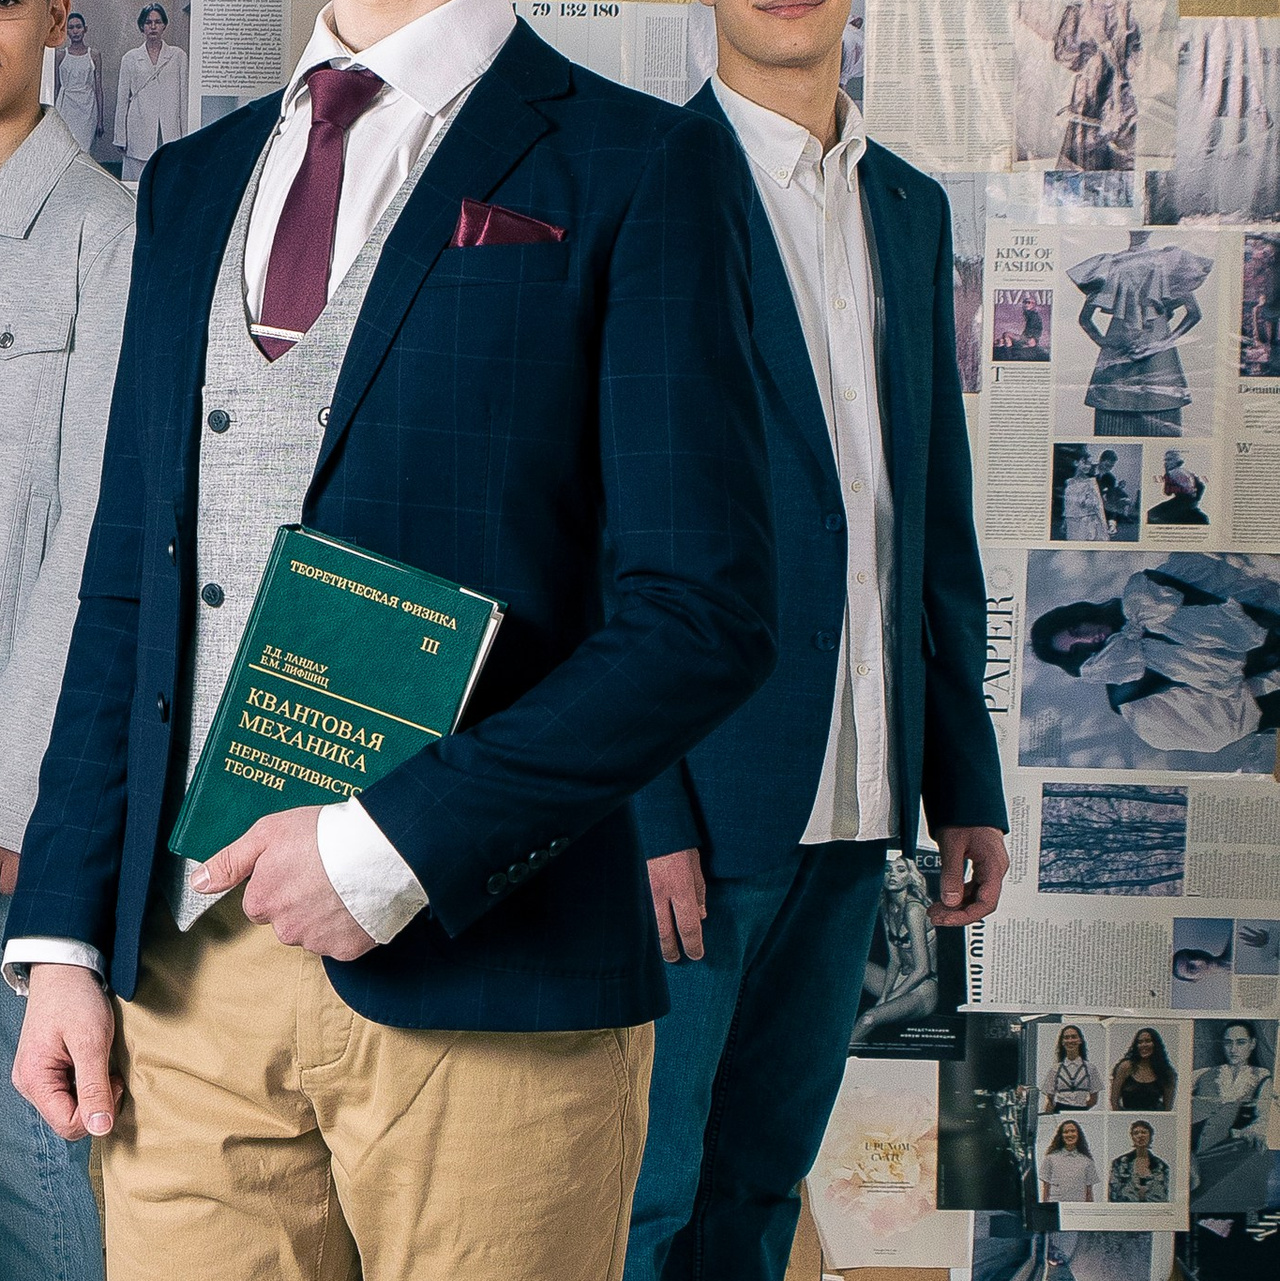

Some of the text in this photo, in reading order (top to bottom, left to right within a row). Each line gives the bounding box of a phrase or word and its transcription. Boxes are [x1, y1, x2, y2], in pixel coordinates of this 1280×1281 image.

[531, 3, 620, 17] 79 132 180
[995, 247, 1054, 259] KING OF
[1012, 235, 1039, 246] THE
[993, 261, 1054, 272] FASHION
[290, 559, 458, 631] ТЕОРЕТИЧЕСКАЯ ФИЗИКА
[262, 644, 330, 675] Л.Д. ЛАНДАУ
[420, 636, 441, 656] III
[984, 592, 1015, 717] PAPER
[281, 662, 330, 689] ЛИФШИЦ
[245, 686, 385, 753] КВАНТОВАЯ
[238, 710, 368, 774] МЕХАНИКА
[224, 757, 287, 792] ТЕОРИЯ
[227, 740, 364, 798] НЕРЕЛЯТИВИСТС
[915, 855, 942, 869] ECR
